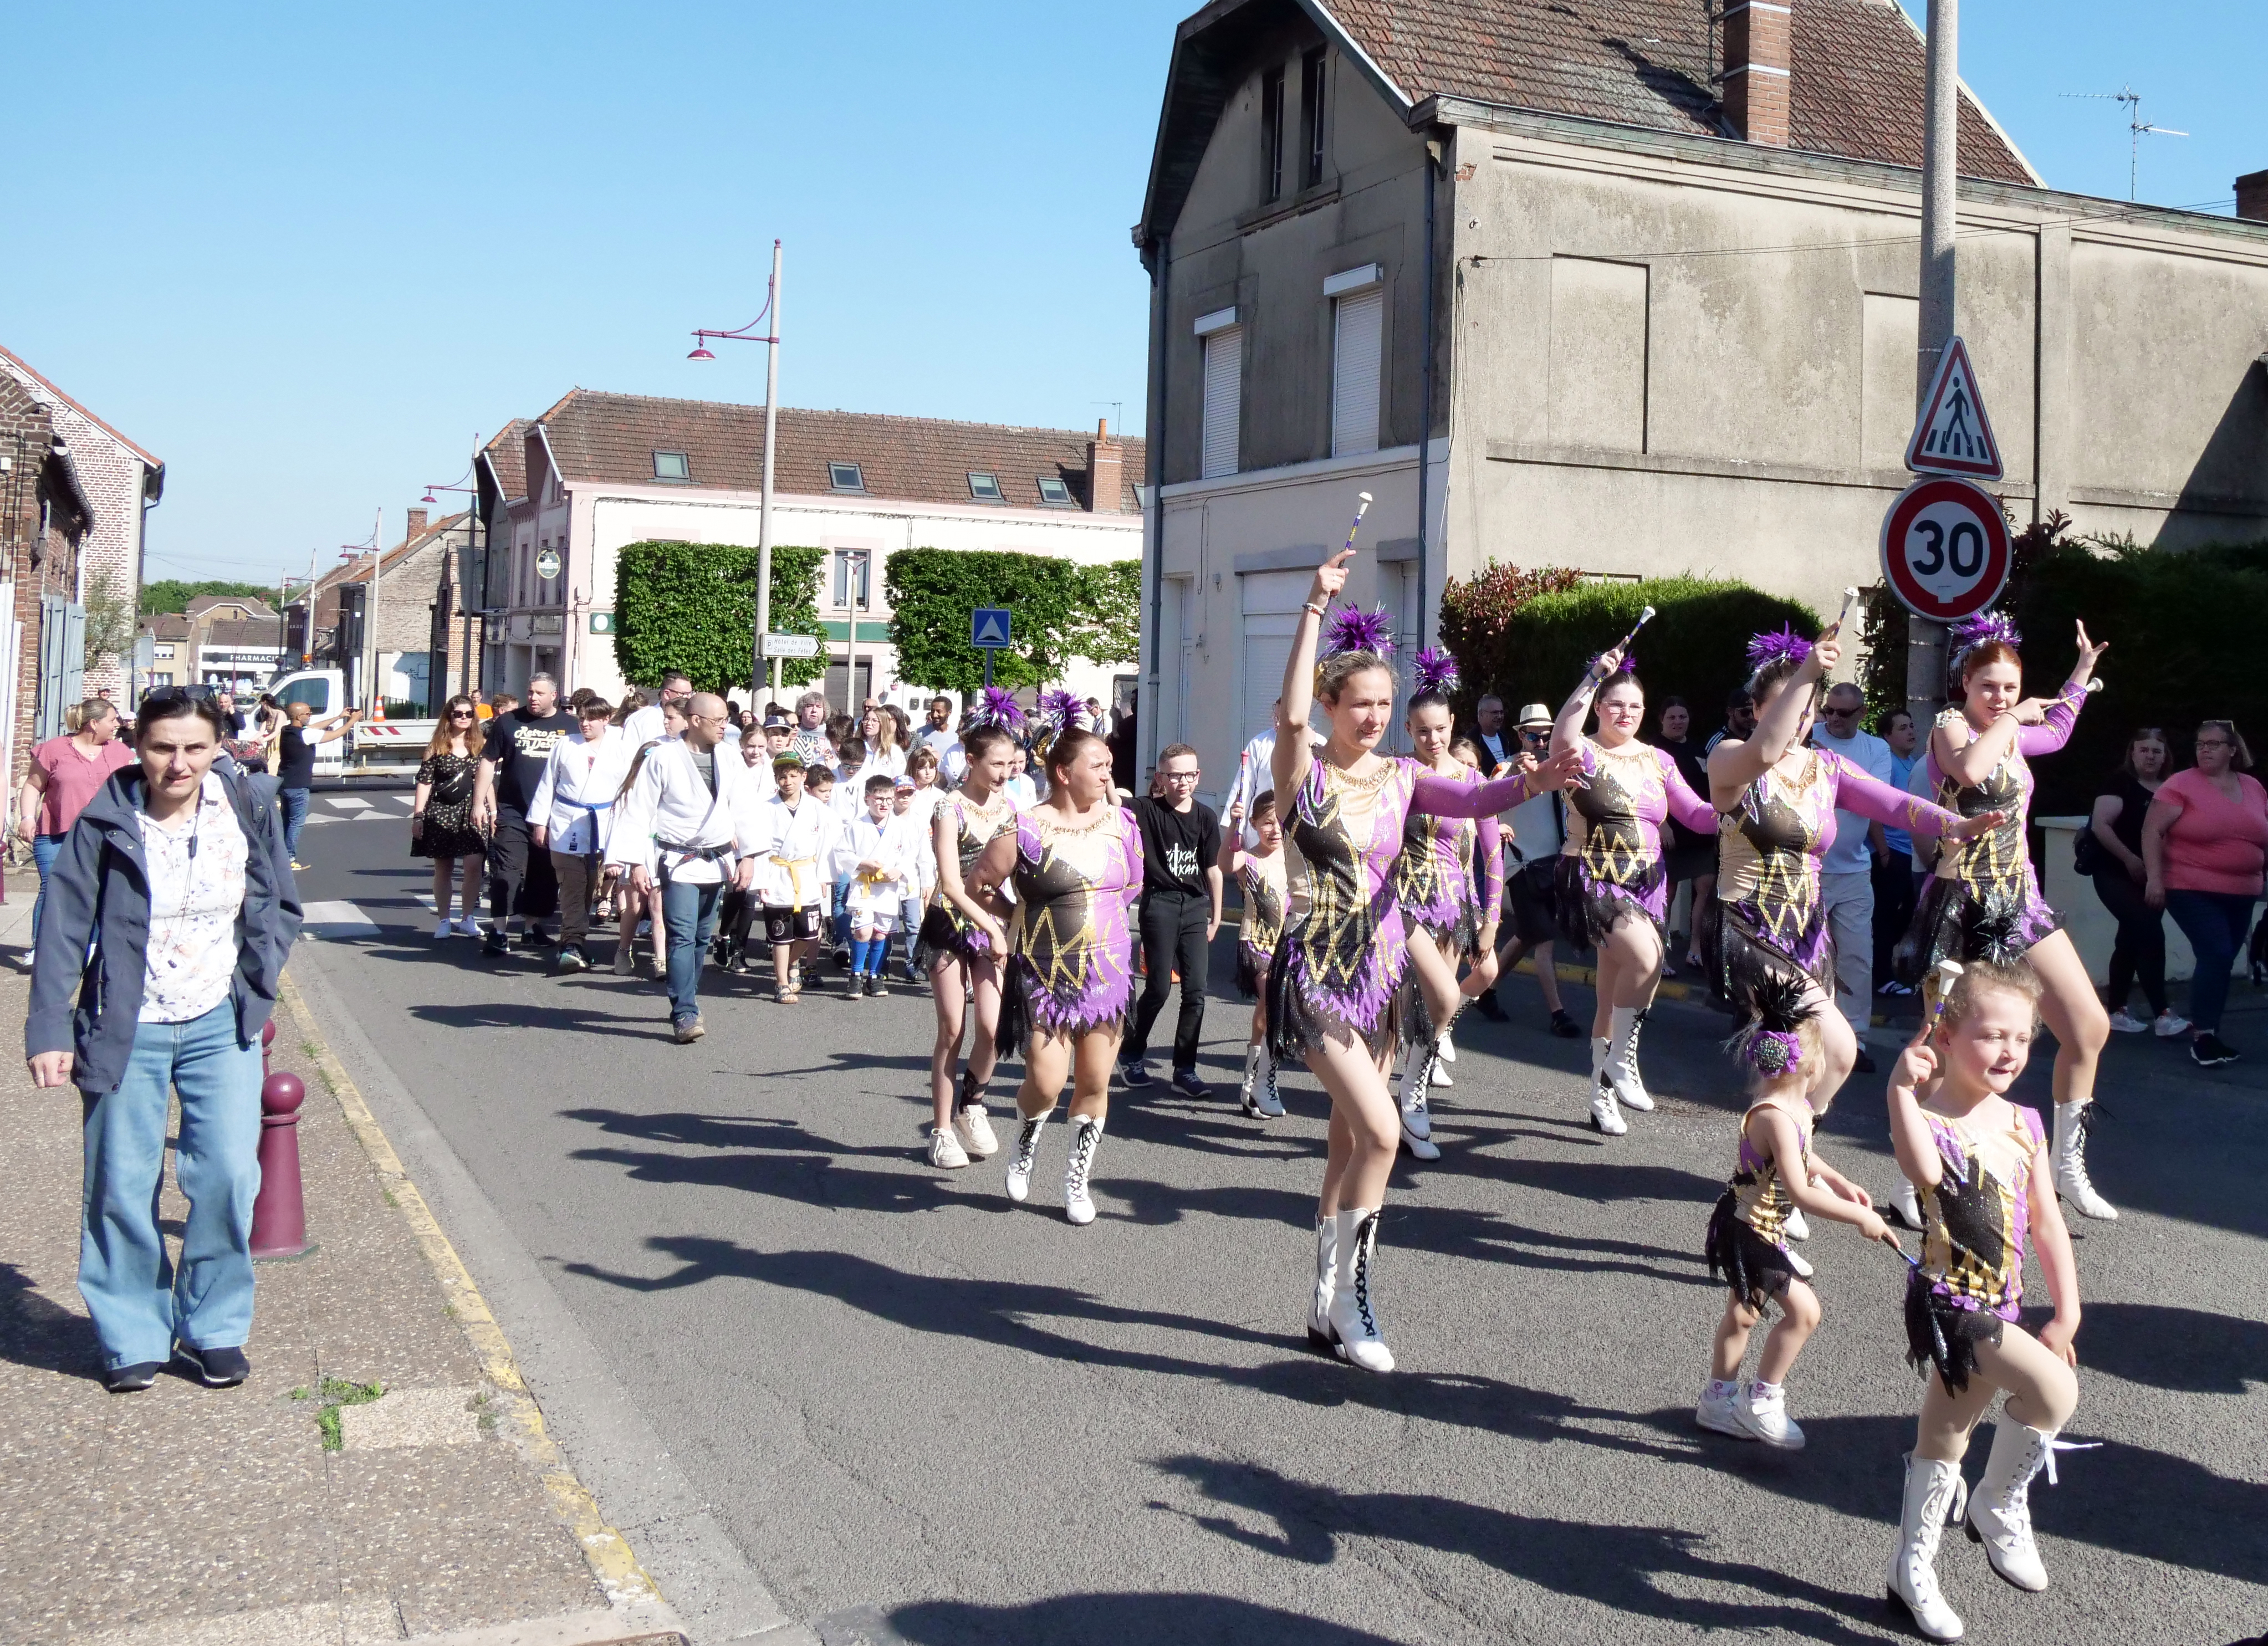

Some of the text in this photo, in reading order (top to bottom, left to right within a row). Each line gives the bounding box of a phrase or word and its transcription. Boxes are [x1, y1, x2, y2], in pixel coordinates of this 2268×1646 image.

[1913, 520, 1983, 577] 30
[514, 726, 548, 738] Retro
[808, 916, 819, 931] 10
